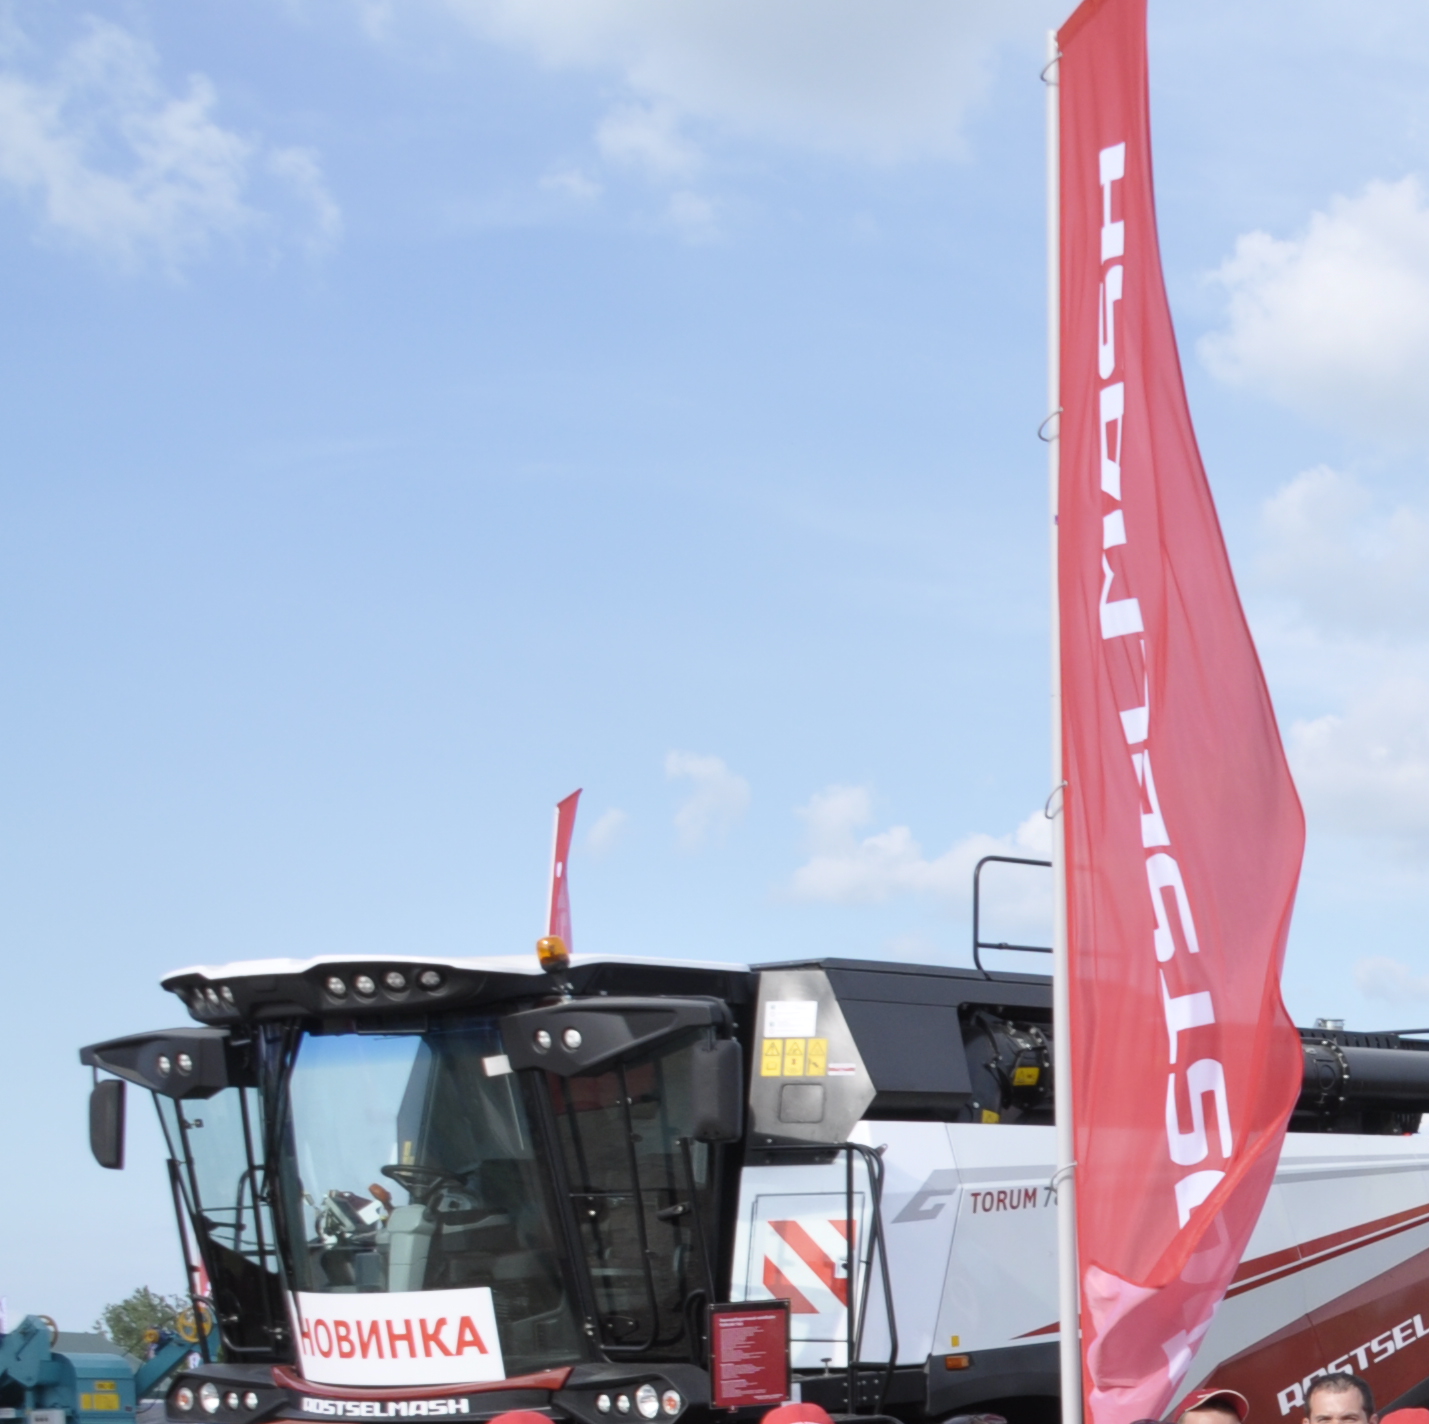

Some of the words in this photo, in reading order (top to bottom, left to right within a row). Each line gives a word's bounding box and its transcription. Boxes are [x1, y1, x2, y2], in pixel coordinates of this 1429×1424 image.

[1098, 142, 1233, 1386] OSTSELMASH
[970, 1187, 1038, 1214] TORUM
[1043, 1186, 1058, 1208] 7
[300, 1315, 489, 1360] НОВИНКА
[302, 1397, 470, 1417] ROSTSELMASH
